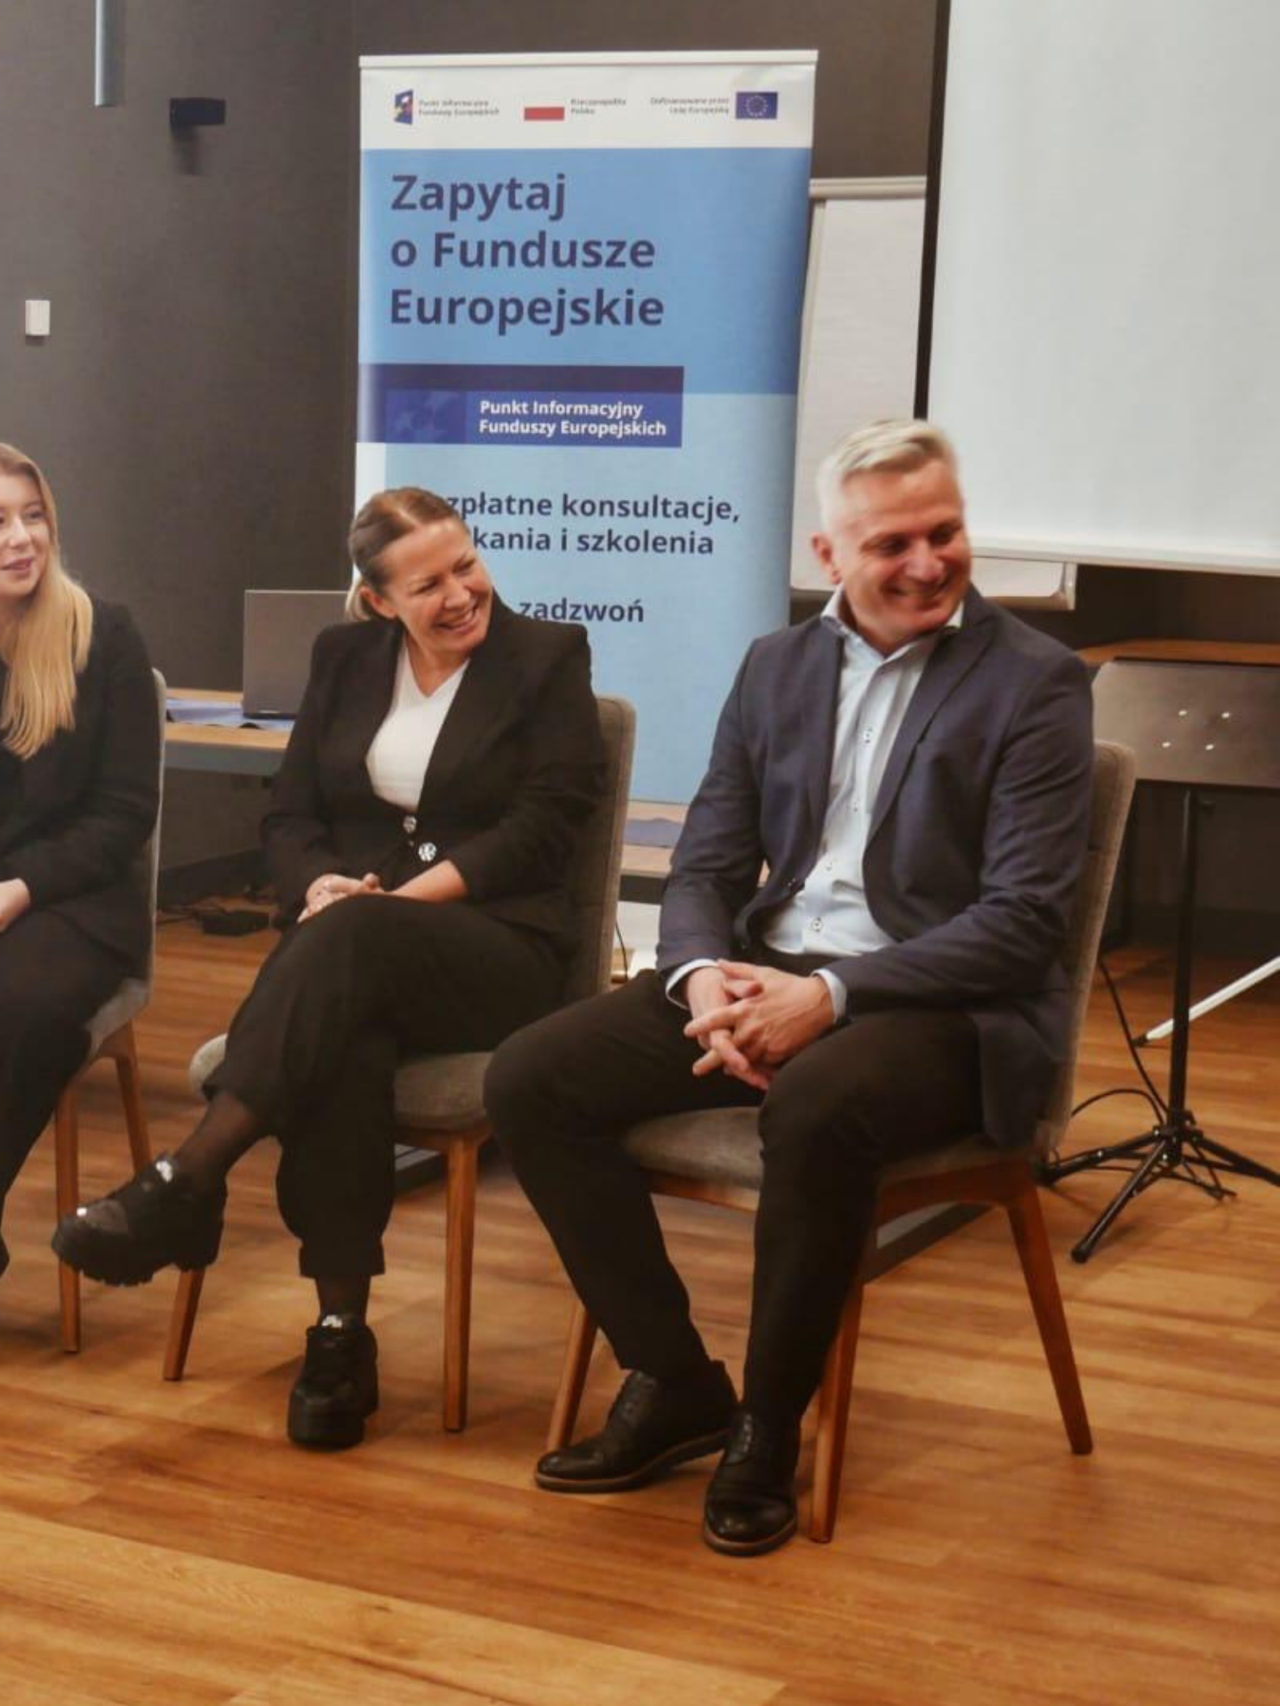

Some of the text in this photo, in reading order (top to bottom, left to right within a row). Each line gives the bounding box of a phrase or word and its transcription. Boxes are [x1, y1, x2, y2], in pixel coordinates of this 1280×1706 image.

[391, 173, 565, 221] Zapytaj
[391, 230, 655, 268] o Fundusze
[391, 288, 664, 336] Europejskie
[480, 400, 643, 419] Punkt Informacyjny
[479, 419, 666, 438] Funduszy Europejskich
[446, 491, 740, 525] zpłatne konsultacje,
[473, 526, 714, 554] kania i szkolenia
[519, 597, 644, 622] zadzwoń
